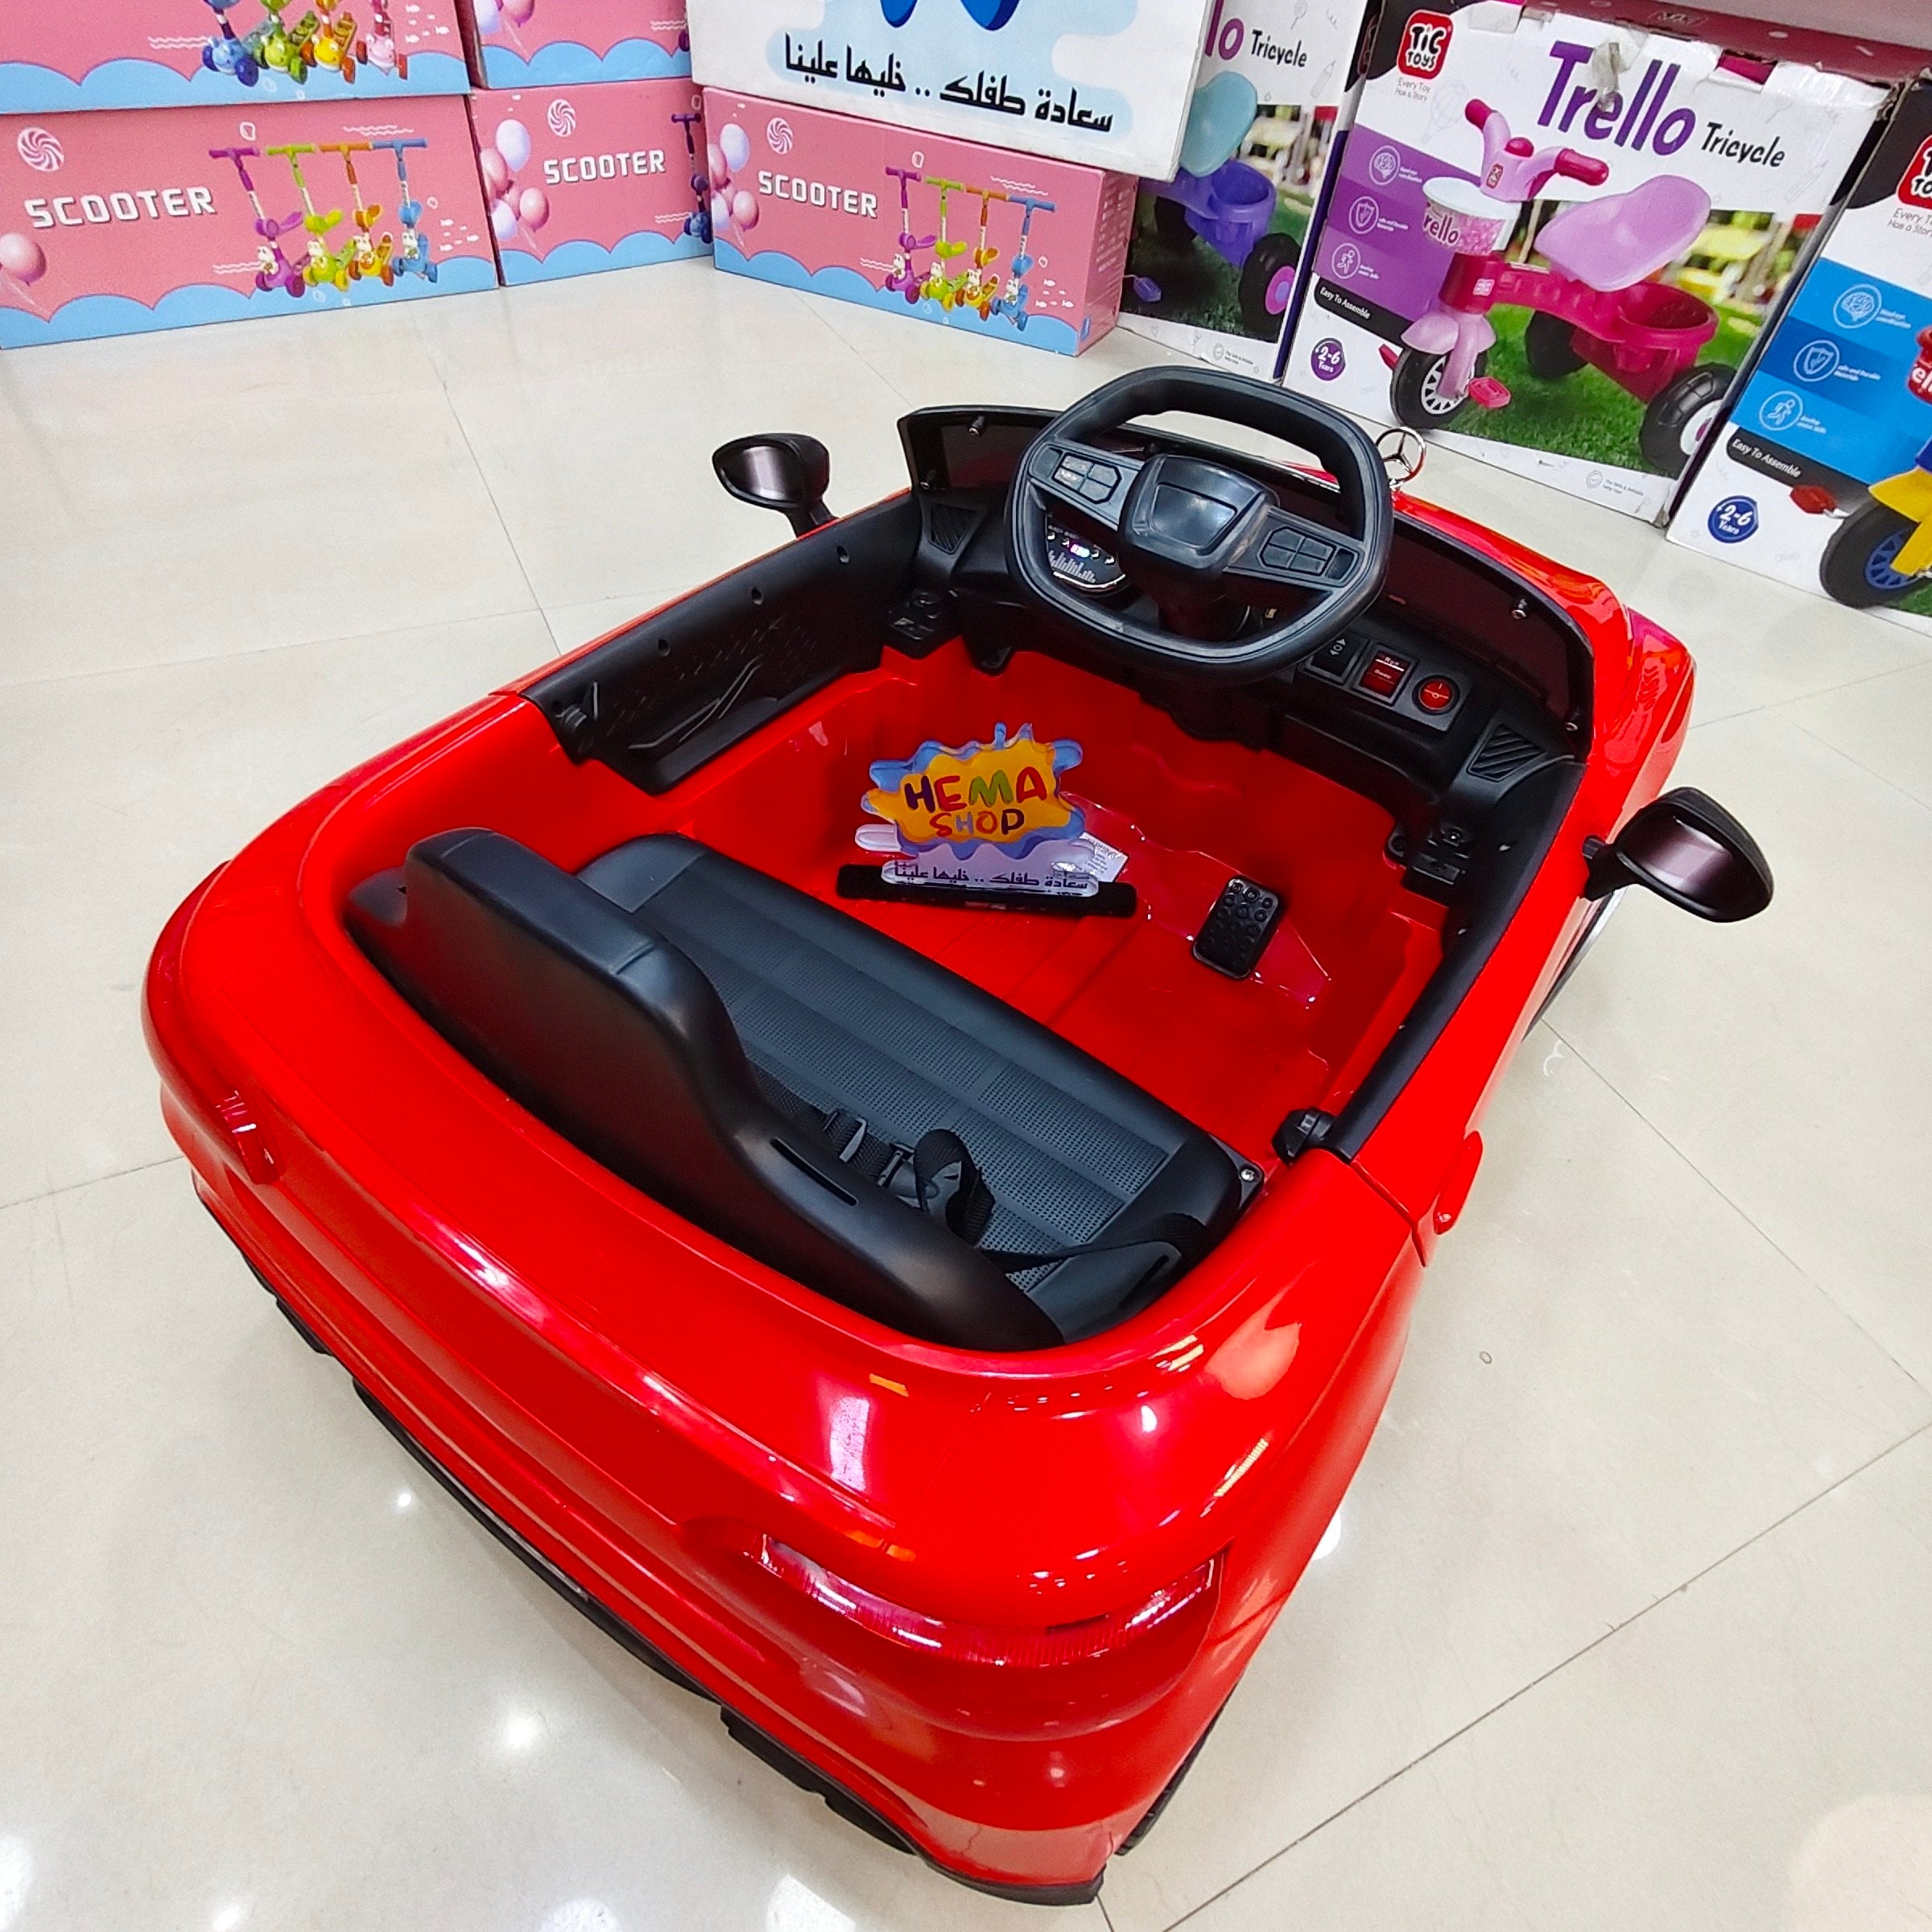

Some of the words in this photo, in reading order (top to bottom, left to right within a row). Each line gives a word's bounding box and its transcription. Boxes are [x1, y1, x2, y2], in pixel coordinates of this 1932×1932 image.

[785, 32, 838, 84] علينا
[1251, 29, 1307, 67] Tricycle
[846, 44, 906, 97] خليها
[1397, 77, 1418, 90] Every
[1419, 82, 1431, 94] Toy
[939, 69, 1026, 116] طفلك
[1537, 40, 1696, 156] Trello
[1701, 122, 1785, 167] Tricycle
[1034, 87, 1113, 133] سعادة
[543, 150, 667, 185] SCOOTER
[24, 186, 217, 229] SCOOTER
[758, 171, 878, 219] SCOOTER
[1893, 208, 1923, 224] Every
[1320, 287, 1334, 300] Easy
[1334, 294, 1342, 303] To
[1342, 299, 1371, 319] Assemble
[1318, 346, 1340, 365] 2-6
[1318, 361, 1334, 372] Years
[1732, 438, 1752, 455] Easy
[1751, 448, 1763, 459] To
[1761, 453, 1802, 477] Assemble
[1719, 505, 1753, 526] 2-6
[1719, 519, 1740, 535] Years
[903, 766, 1047, 813] HEMA
[929, 808, 1025, 836] SHOP
[894, 865, 928, 881] علينا
[933, 867, 969, 883] خليها
[989, 872, 1039, 886] طفلك
[1044, 876, 1088, 889] سعادة
